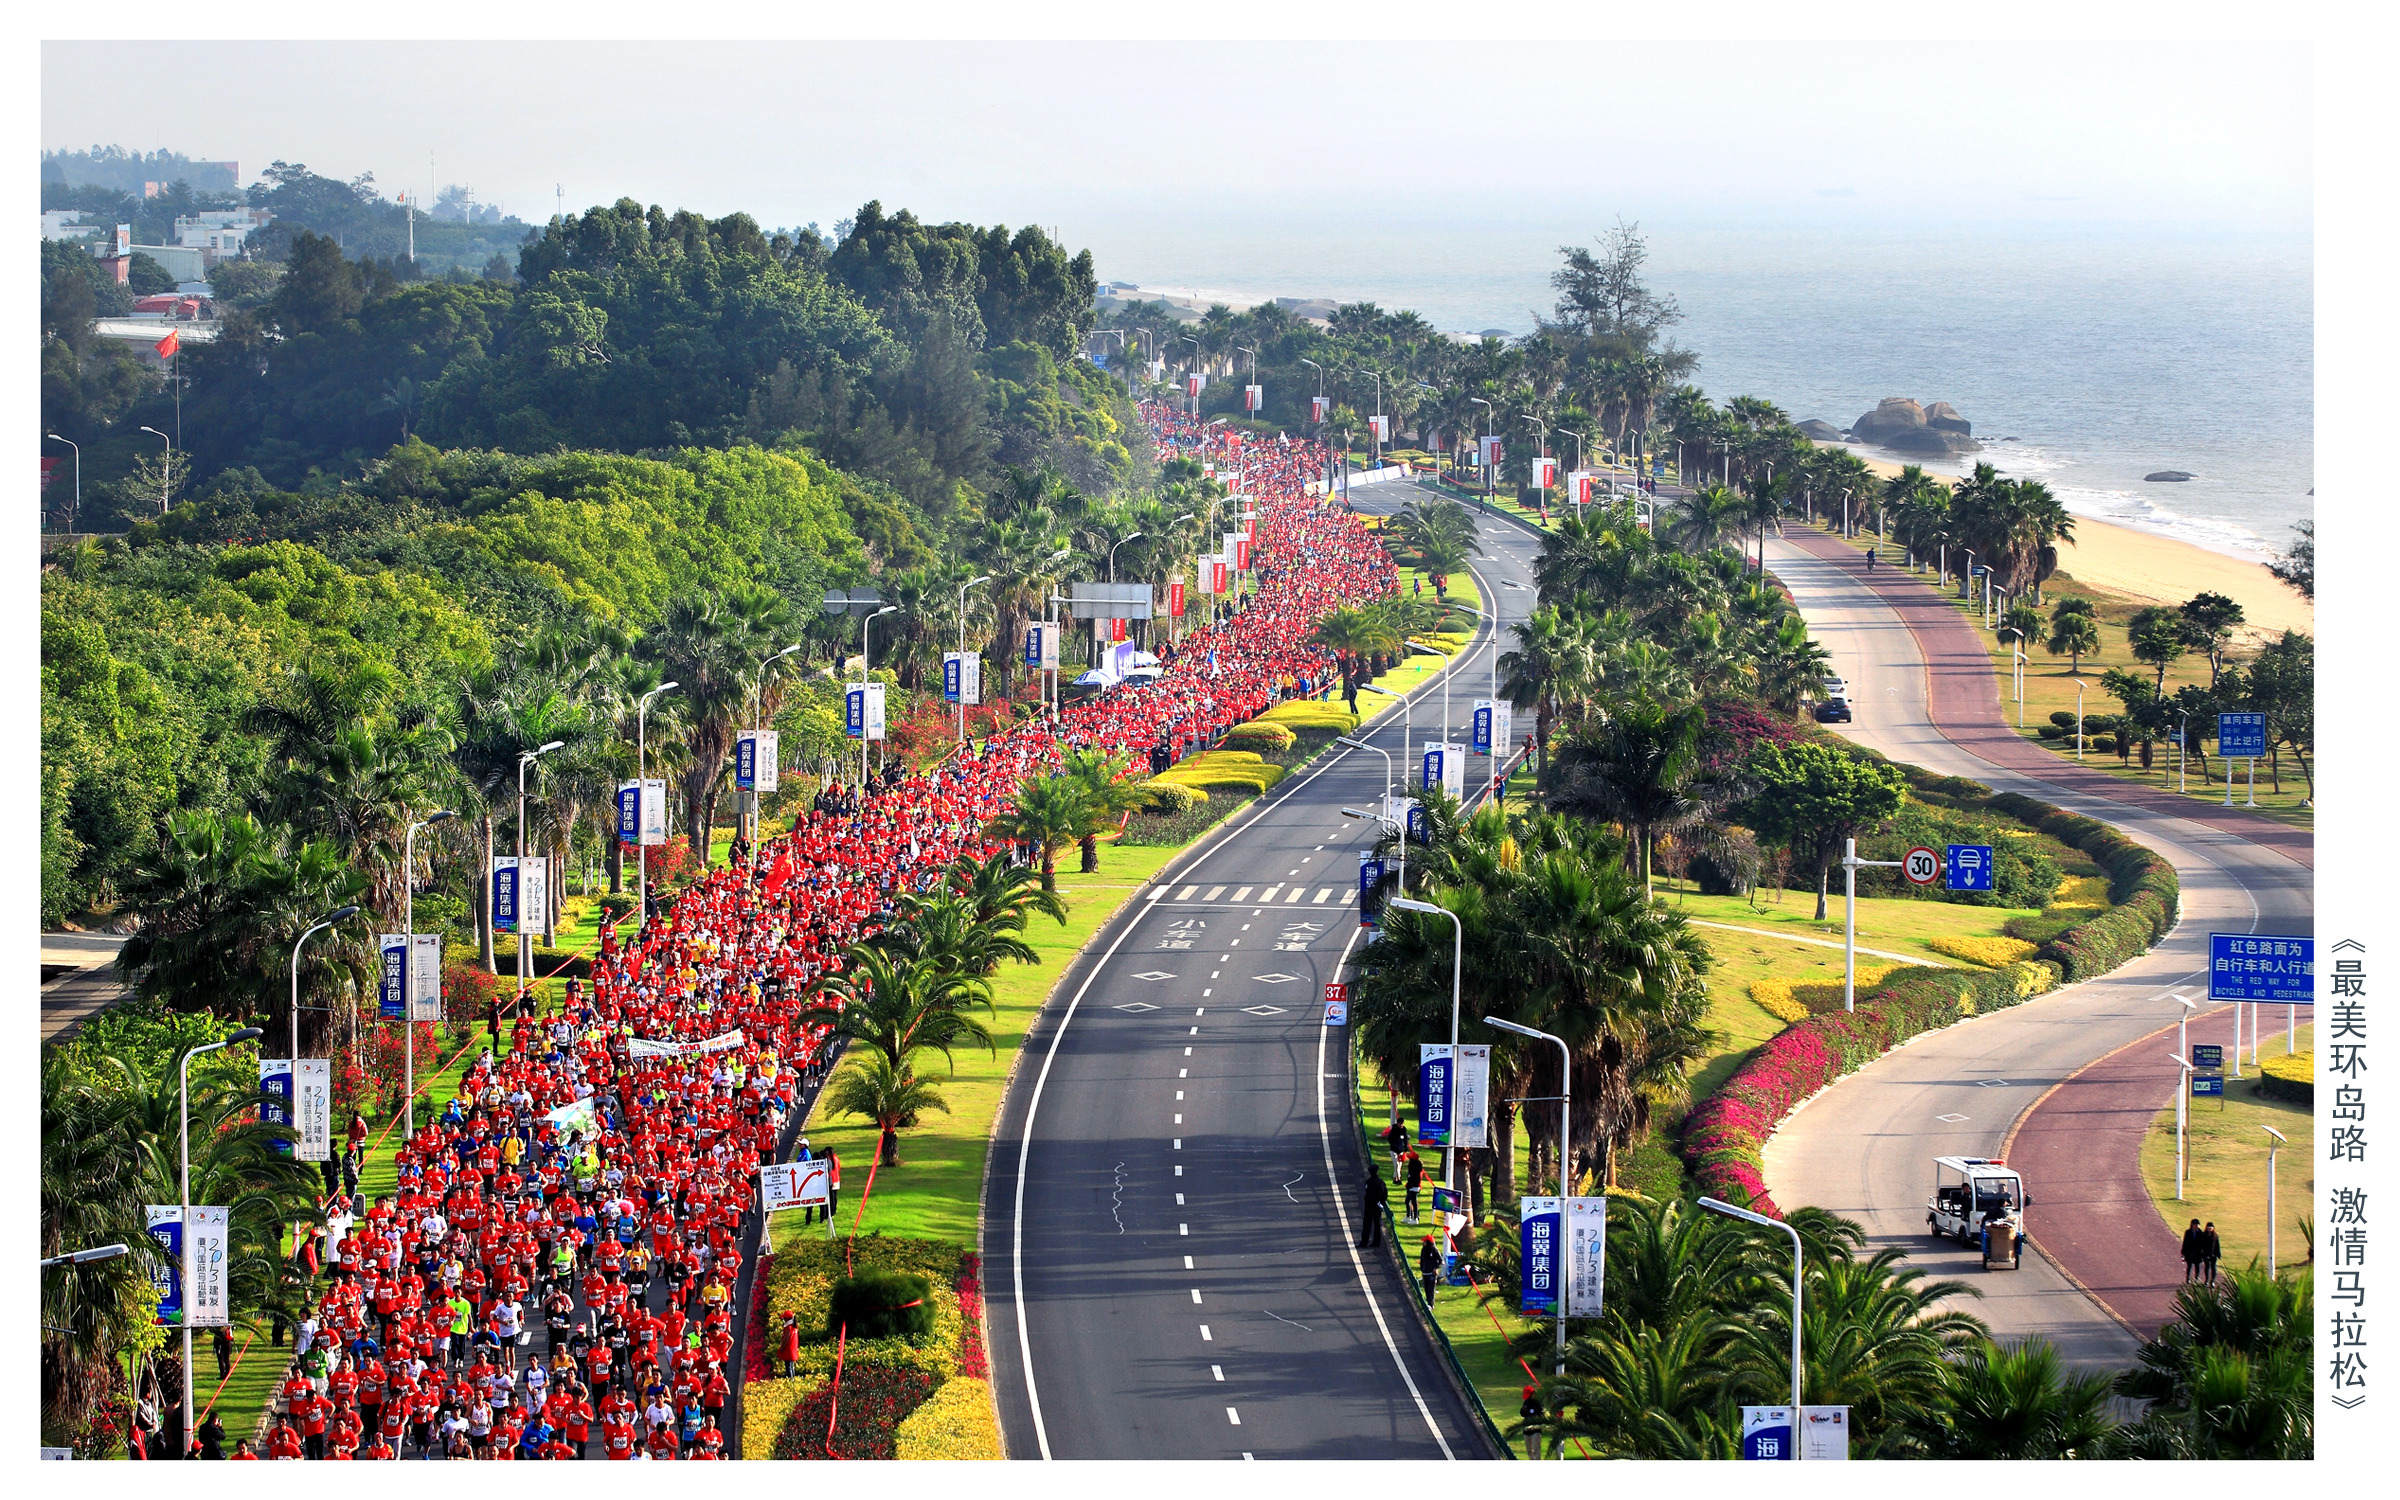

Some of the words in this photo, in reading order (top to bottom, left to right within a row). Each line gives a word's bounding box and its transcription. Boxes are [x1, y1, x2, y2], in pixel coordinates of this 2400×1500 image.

[2223, 736, 2262, 746] 禁止逆行
[1911, 856, 1932, 876] 30
[2230, 940, 2302, 957] 红色路面为
[2215, 958, 2314, 976] 自行车和人行道
[387, 952, 400, 1001] 海翼集团
[2231, 976, 2243, 985] THE
[2250, 976, 2262, 985] RED
[2268, 977, 2280, 986] WAY
[2287, 978, 2300, 987] FOR
[1326, 986, 1340, 999] 37
[2215, 987, 2245, 996] BICYCLES
[2253, 988, 2266, 997] AND
[2273, 989, 2314, 999] PEDESTRIANS
[1428, 1065, 1444, 1122] 海翼集团
[1532, 1222, 1549, 1289] 海翼集团
[209, 1238, 222, 1307] 2013建发
